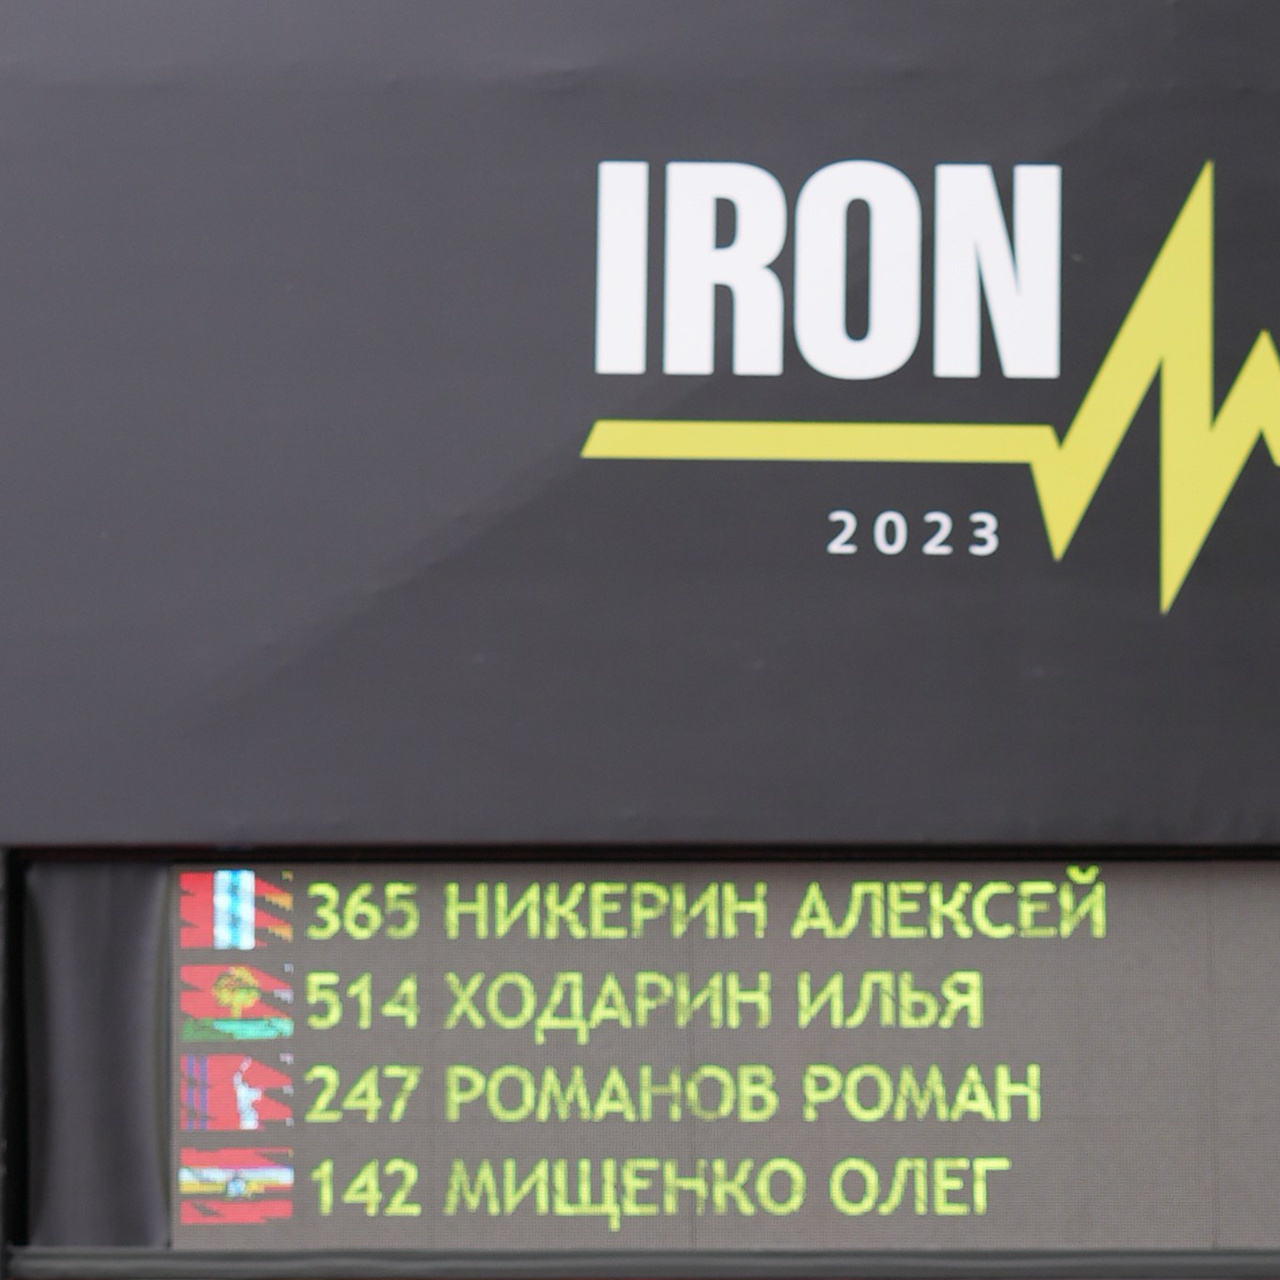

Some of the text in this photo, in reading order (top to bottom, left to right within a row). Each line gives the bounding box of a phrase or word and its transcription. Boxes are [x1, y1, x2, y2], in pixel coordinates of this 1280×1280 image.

[595, 159, 1062, 381] IRON
[827, 510, 1000, 556] 2023
[306, 865, 1106, 938] 365 НИКЕРИН АЛЕКСЕЙ
[305, 971, 983, 1044] 514 ХОДАРИН ИЛЬЯ
[305, 1064, 1041, 1121] 247 РОМАНОВ РОМАН
[312, 1157, 1011, 1231] 142 МИЩЕНКО ОЛЕГ
